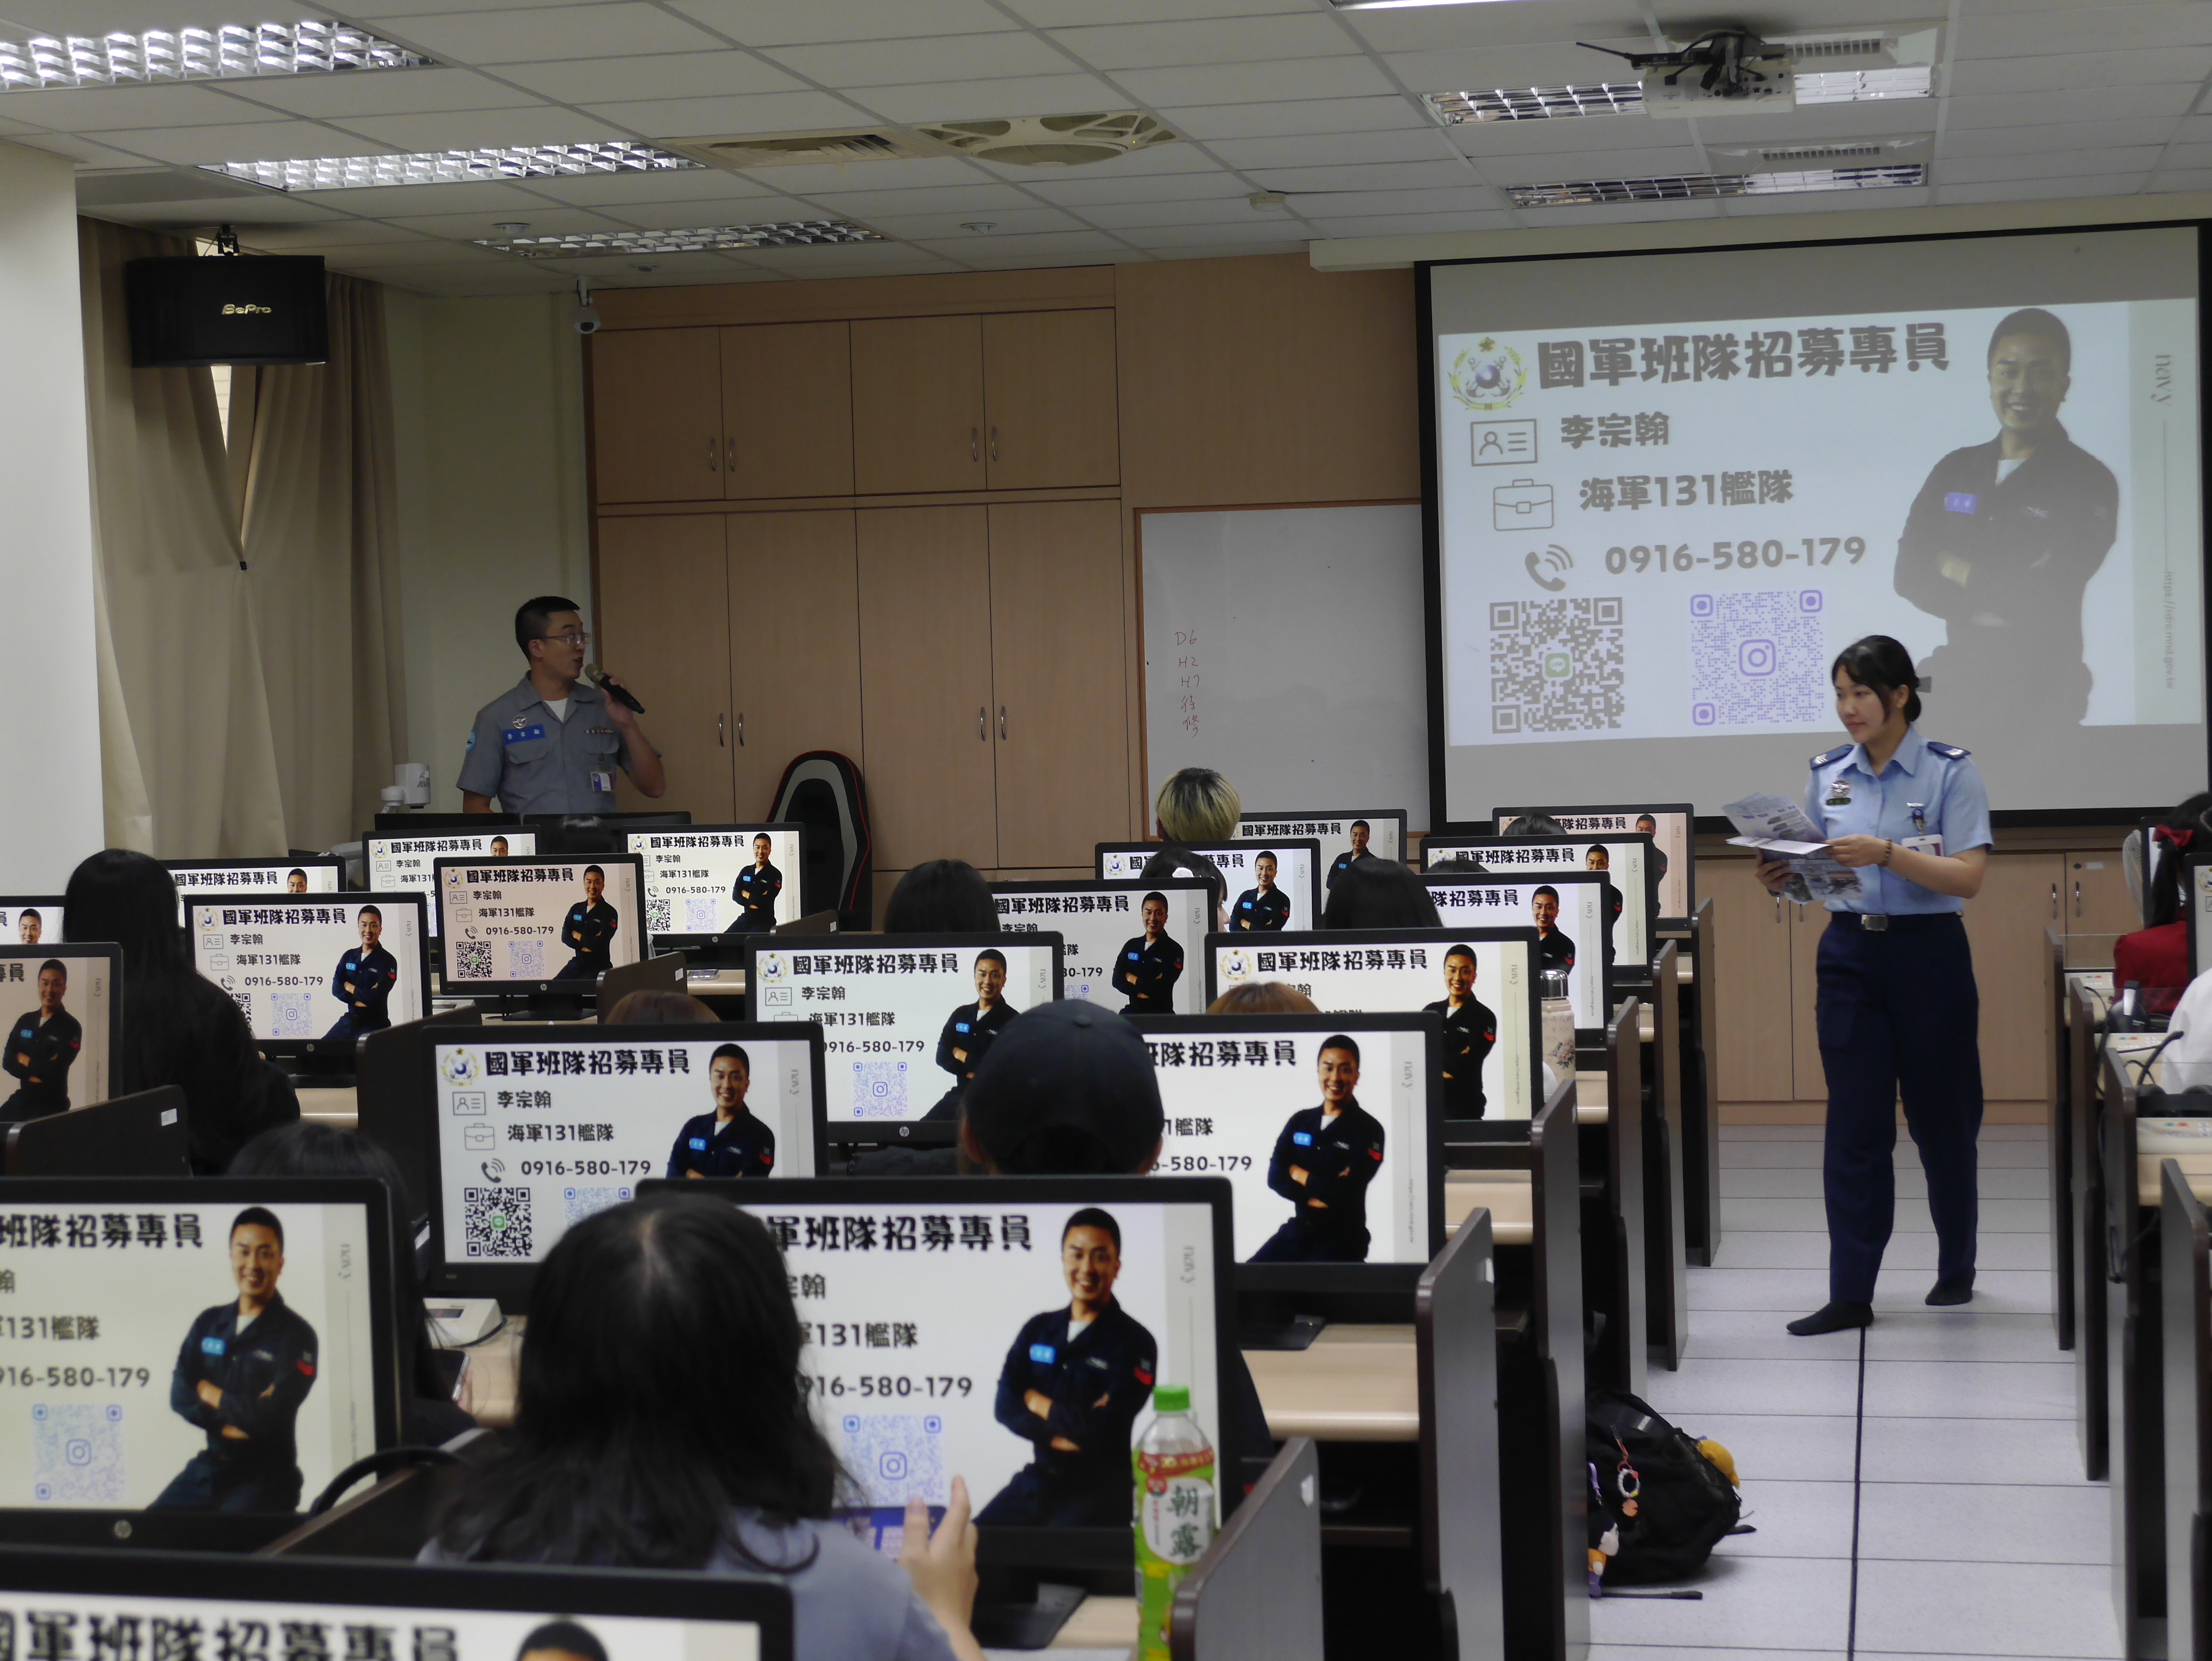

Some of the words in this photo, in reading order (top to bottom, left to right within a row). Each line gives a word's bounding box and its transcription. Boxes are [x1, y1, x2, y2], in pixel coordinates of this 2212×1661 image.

[222, 304, 272, 315] BePro
[1538, 322, 1949, 389] 國軍班隊招募專員
[2151, 355, 2172, 406] navy
[1561, 411, 1670, 449] 李宗翰
[1579, 469, 1794, 512] 海軍131艦隊
[1605, 536, 1866, 575] 0916-580-179
[1242, 822, 1341, 836] 國軍班隊招募專員
[391, 839, 482, 853] 國軍班隊招募專員
[650, 835, 744, 848] 國軍班隊招募專員
[396, 859, 421, 868] 李宗翰
[656, 855, 681, 863] 李宗翰
[175, 871, 277, 886] 國軍班隊招募專員
[401, 874, 434, 883] 海軍131
[466, 868, 574, 883] 國軍班隊招募專員
[660, 870, 709, 879] 海軍131艦隊
[473, 890, 501, 900] 李宗翰
[478, 907, 535, 918] 海軍131艦隊
[994, 896, 1129, 914] 國軍班隊招募專員
[223, 908, 346, 925] 國軍班隊招募專員
[486, 926, 554, 935] 0916-580-179
[230, 934, 263, 945] 李宗翰
[236, 954, 301, 966] 海軍131艦隊
[793, 953, 959, 975] 國軍班隊招募專員
[1257, 949, 1427, 972] 國軍班隊招募專員
[245, 976, 323, 986] 0916-580-179
[802, 986, 845, 1001] 李宗翰
[809, 1012, 895, 1027] 海軍131艦隊
[485, 1049, 690, 1076] 國軍班隊招募專員
[498, 1090, 551, 1108] 李宗翰
[507, 1123, 614, 1142] 海軍131艦隊
[521, 1160, 651, 1175] 0916-580-179
[0, 1316, 100, 1341] 131艦隊
